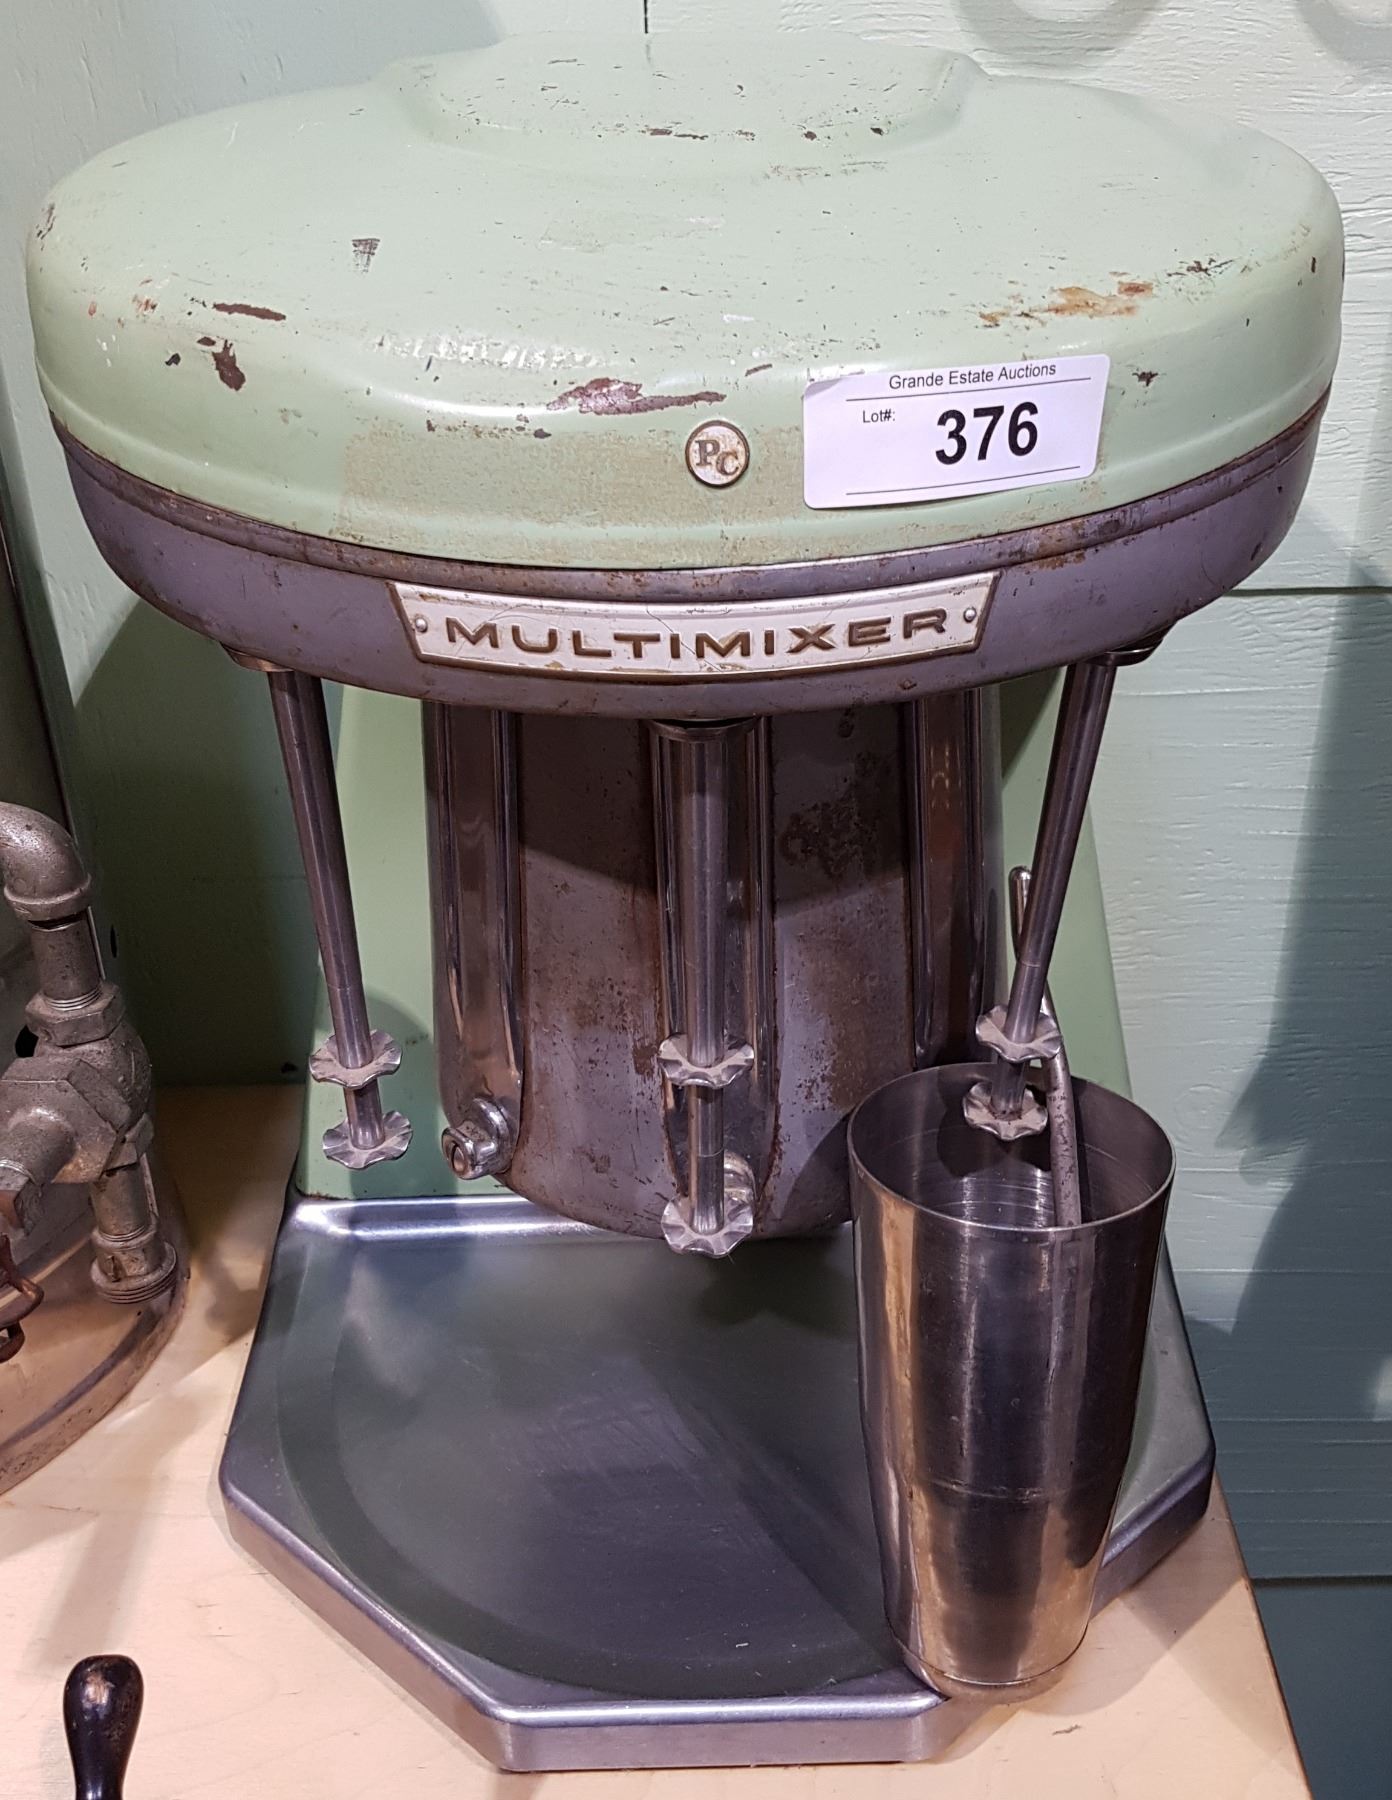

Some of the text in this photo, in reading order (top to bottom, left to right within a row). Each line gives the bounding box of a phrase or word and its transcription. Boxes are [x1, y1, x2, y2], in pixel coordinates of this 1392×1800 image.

[889, 363, 1057, 389] Grande Estate Auctions
[862, 401, 1039, 465] Lot#: 376
[446, 608, 947, 659] MULTIMIXER
